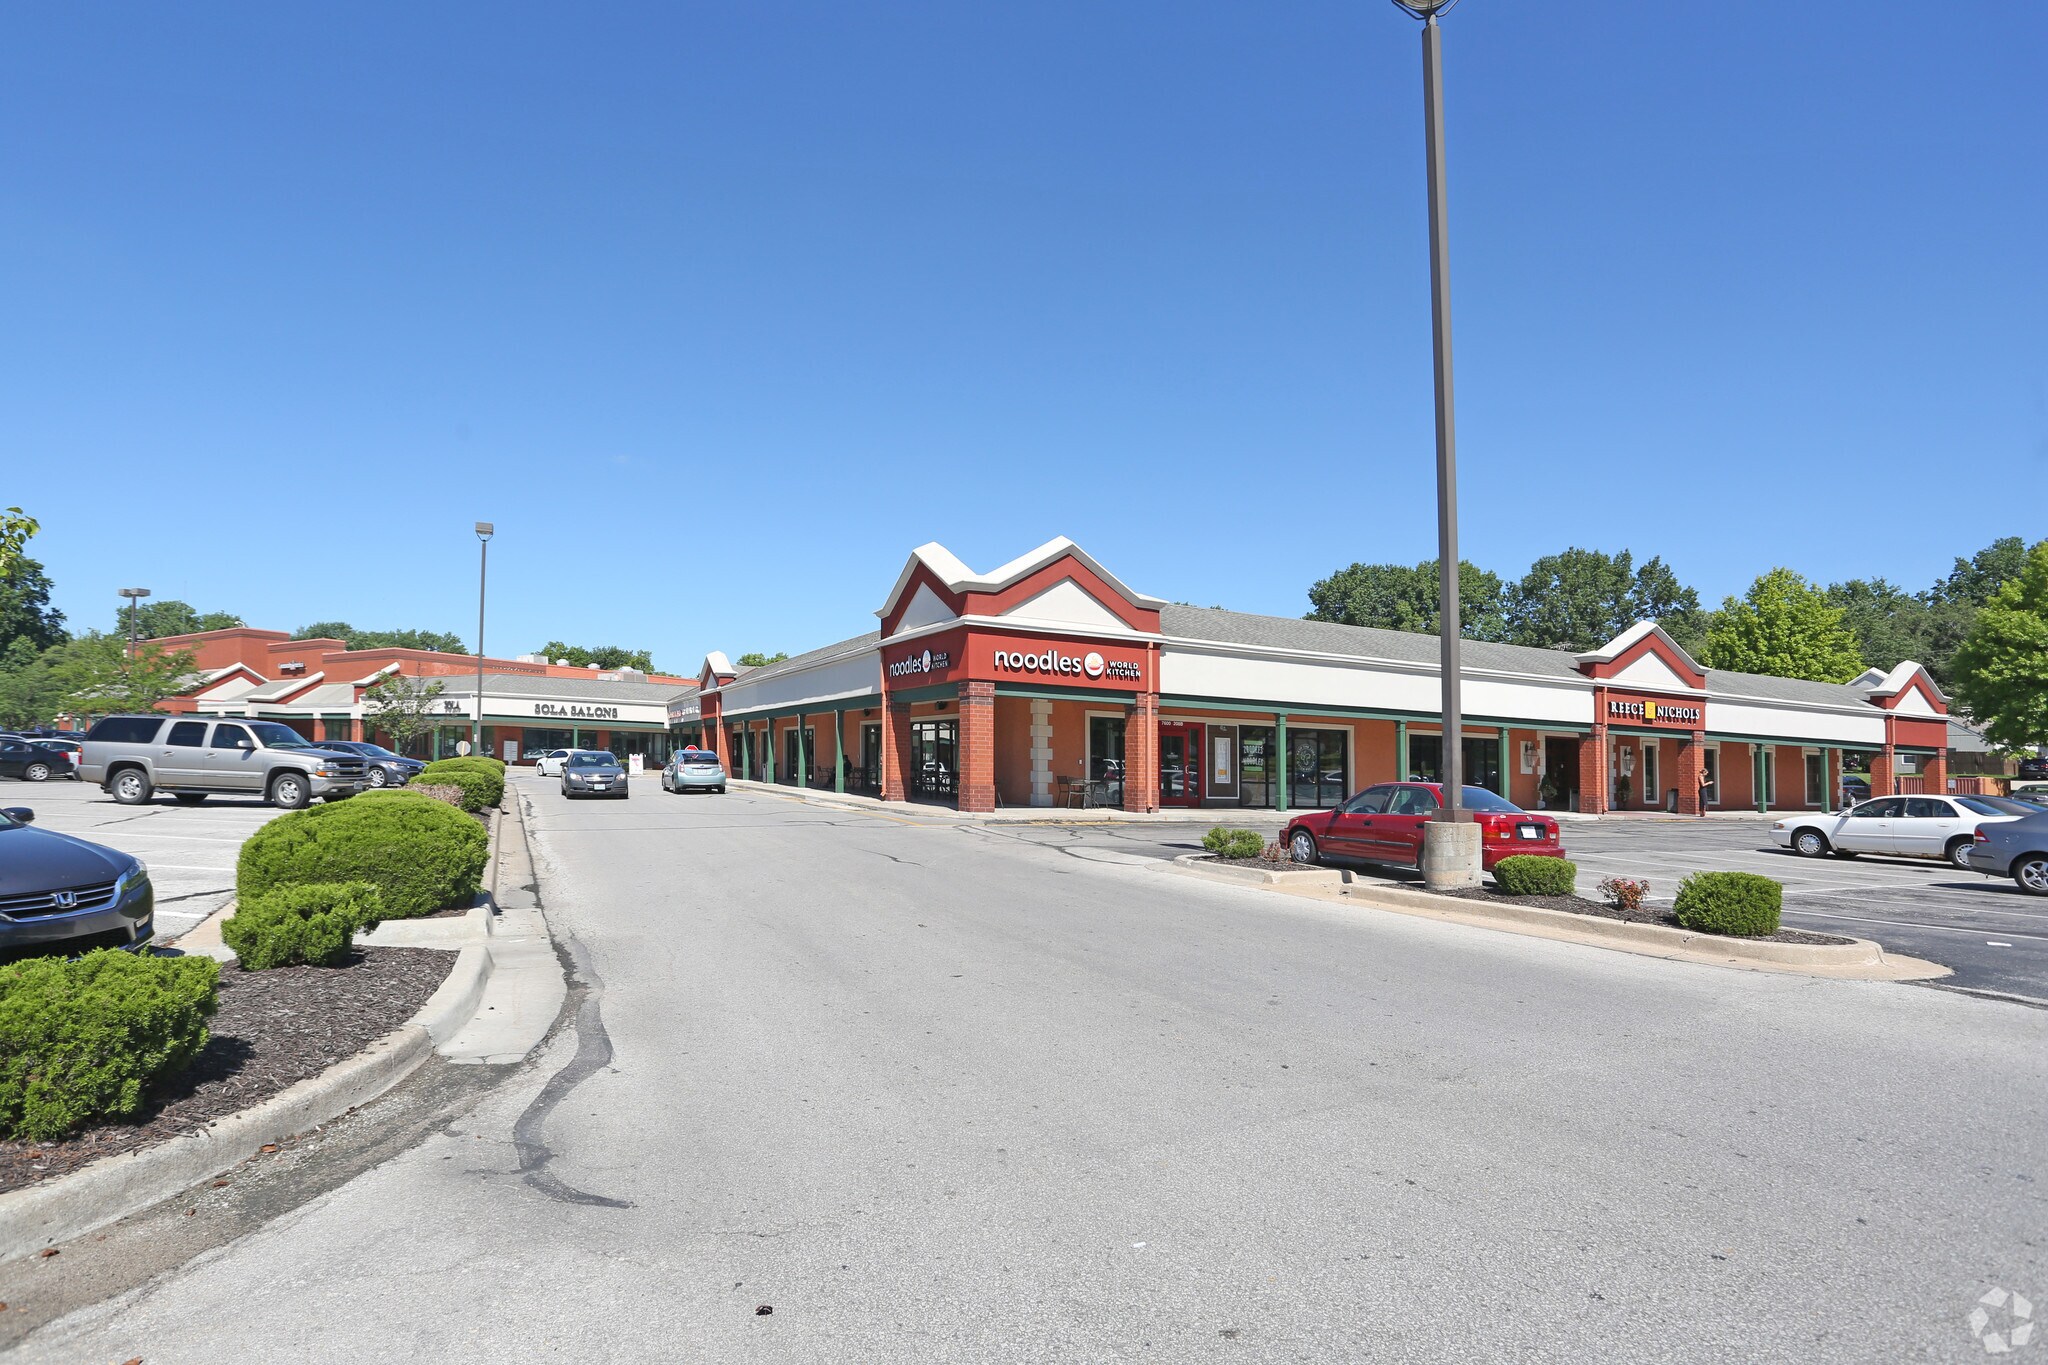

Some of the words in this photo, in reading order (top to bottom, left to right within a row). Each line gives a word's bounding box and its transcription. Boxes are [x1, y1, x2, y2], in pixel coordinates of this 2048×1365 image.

[890, 655, 921, 677] noodles
[994, 650, 1082, 673] noodles
[1110, 661, 1139, 669] WORLD
[1106, 668, 1141, 677] KITCHEN
[534, 703, 568, 716] SOLA
[570, 705, 618, 719] SALONS
[1611, 701, 1644, 715] REECE
[1657, 706, 1700, 719] NICHOLS
